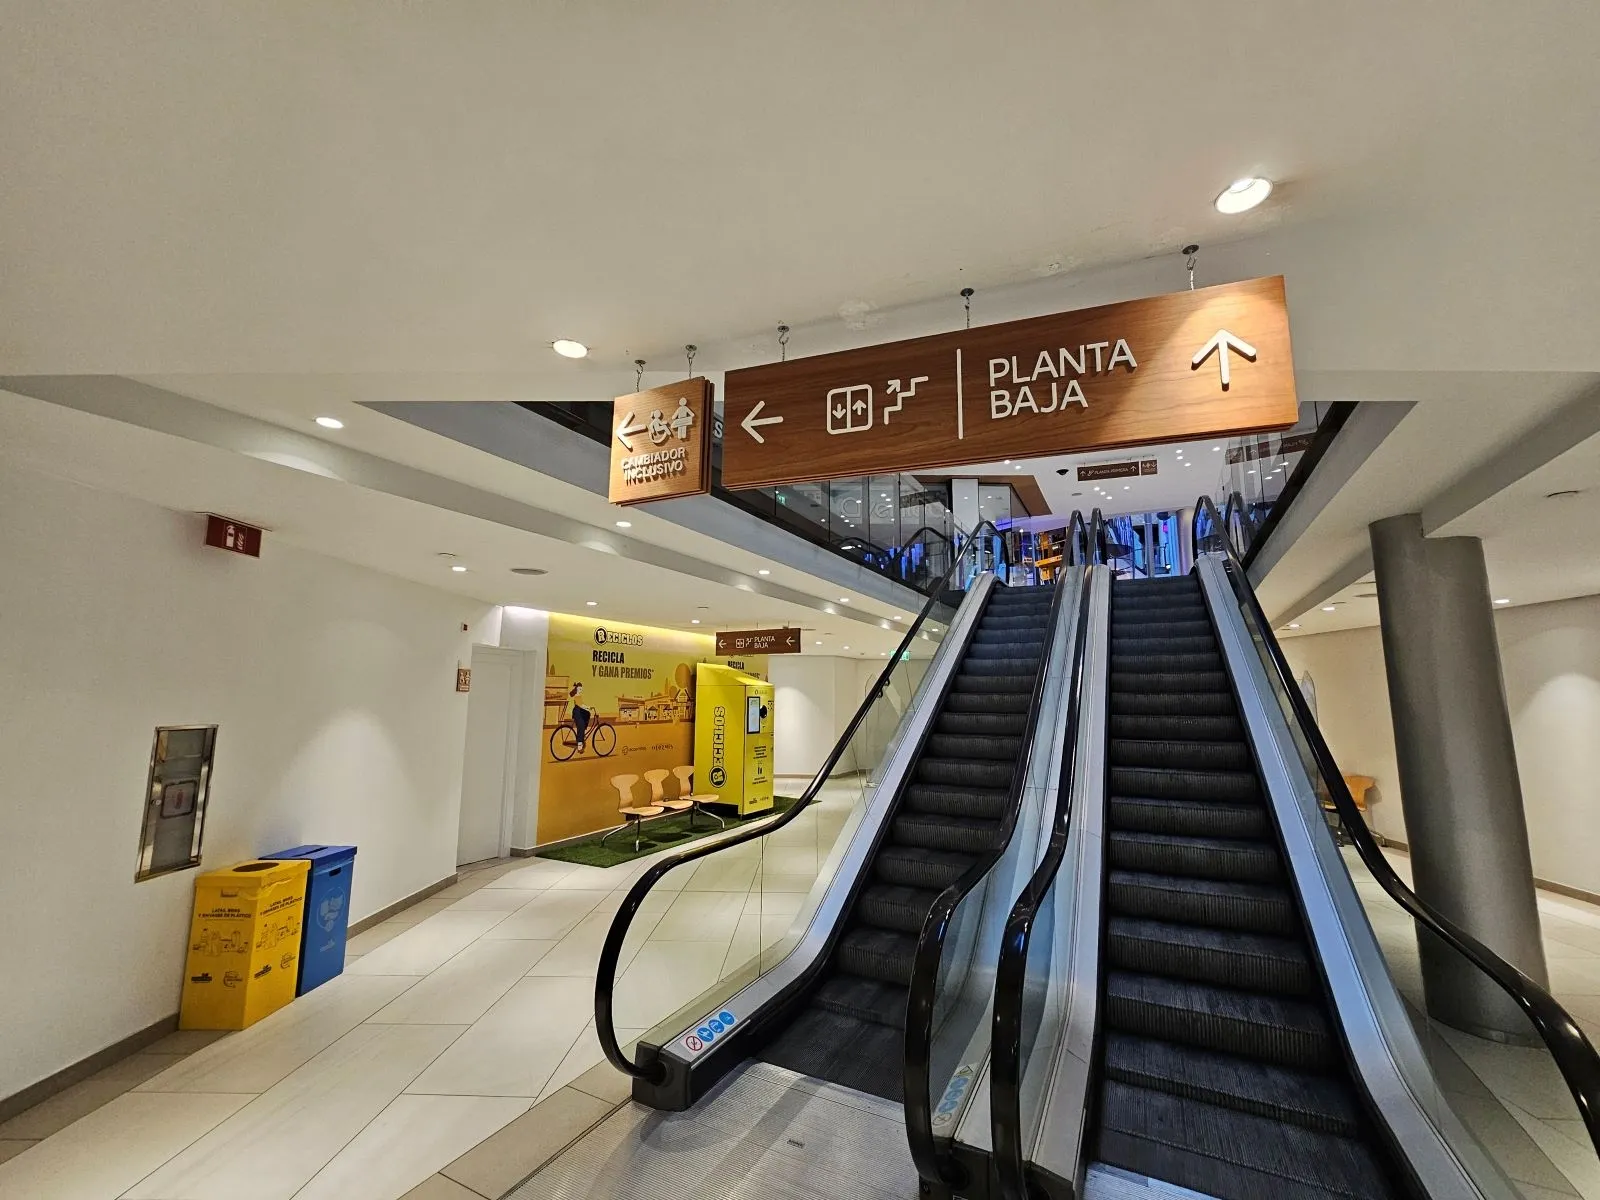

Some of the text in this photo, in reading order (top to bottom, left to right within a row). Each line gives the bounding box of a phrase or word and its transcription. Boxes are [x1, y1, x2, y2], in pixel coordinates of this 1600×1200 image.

[989, 339, 1137, 387] PLANTA
[990, 379, 1088, 419] BAJA
[622, 447, 686, 470] CAMBIADOR
[624, 460, 683, 480] INCLUSIVO
[594, 627, 643, 646] RECICLOS
[592, 650, 625, 664] RECICLA
[592, 665, 598, 677] Y
[598, 665, 619, 678] GANA
[711, 706, 726, 786] RECICLOS
